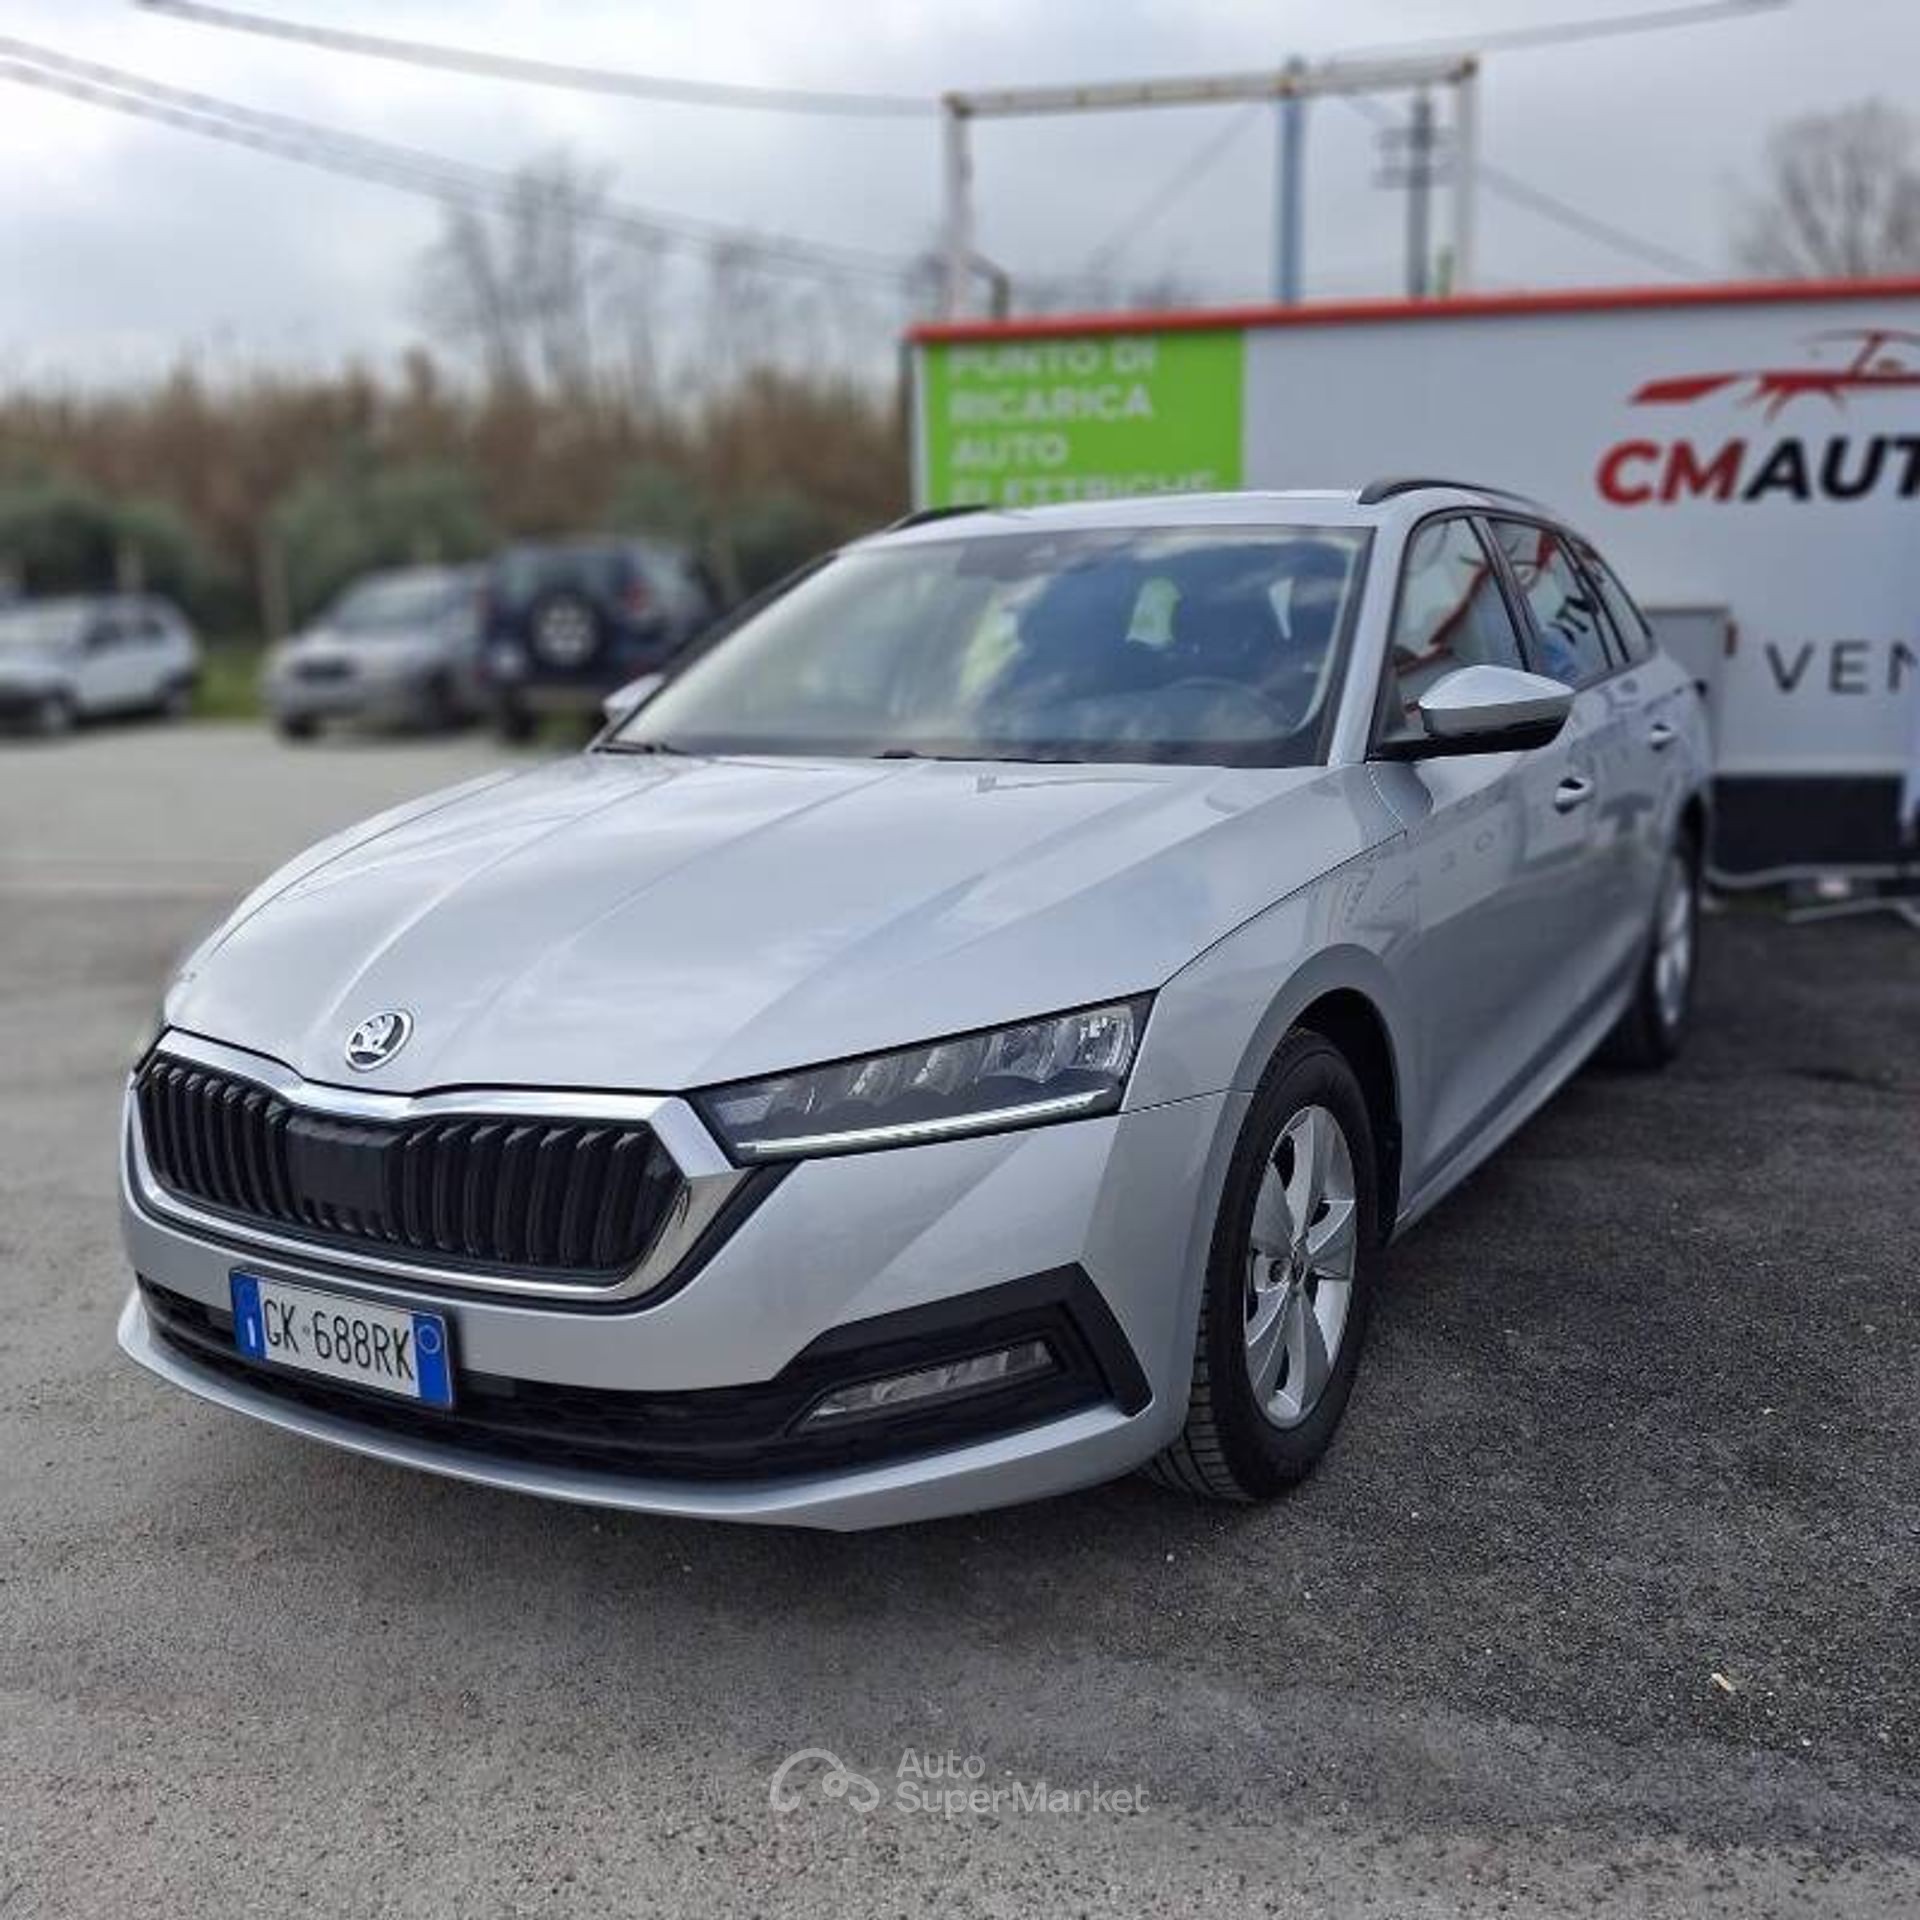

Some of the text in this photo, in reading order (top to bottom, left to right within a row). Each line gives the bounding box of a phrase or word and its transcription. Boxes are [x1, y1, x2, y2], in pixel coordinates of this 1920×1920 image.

[949, 338, 1156, 376] PUNTO DI
[949, 384, 1155, 423] RICARICA
[951, 432, 1068, 466] AUTO
